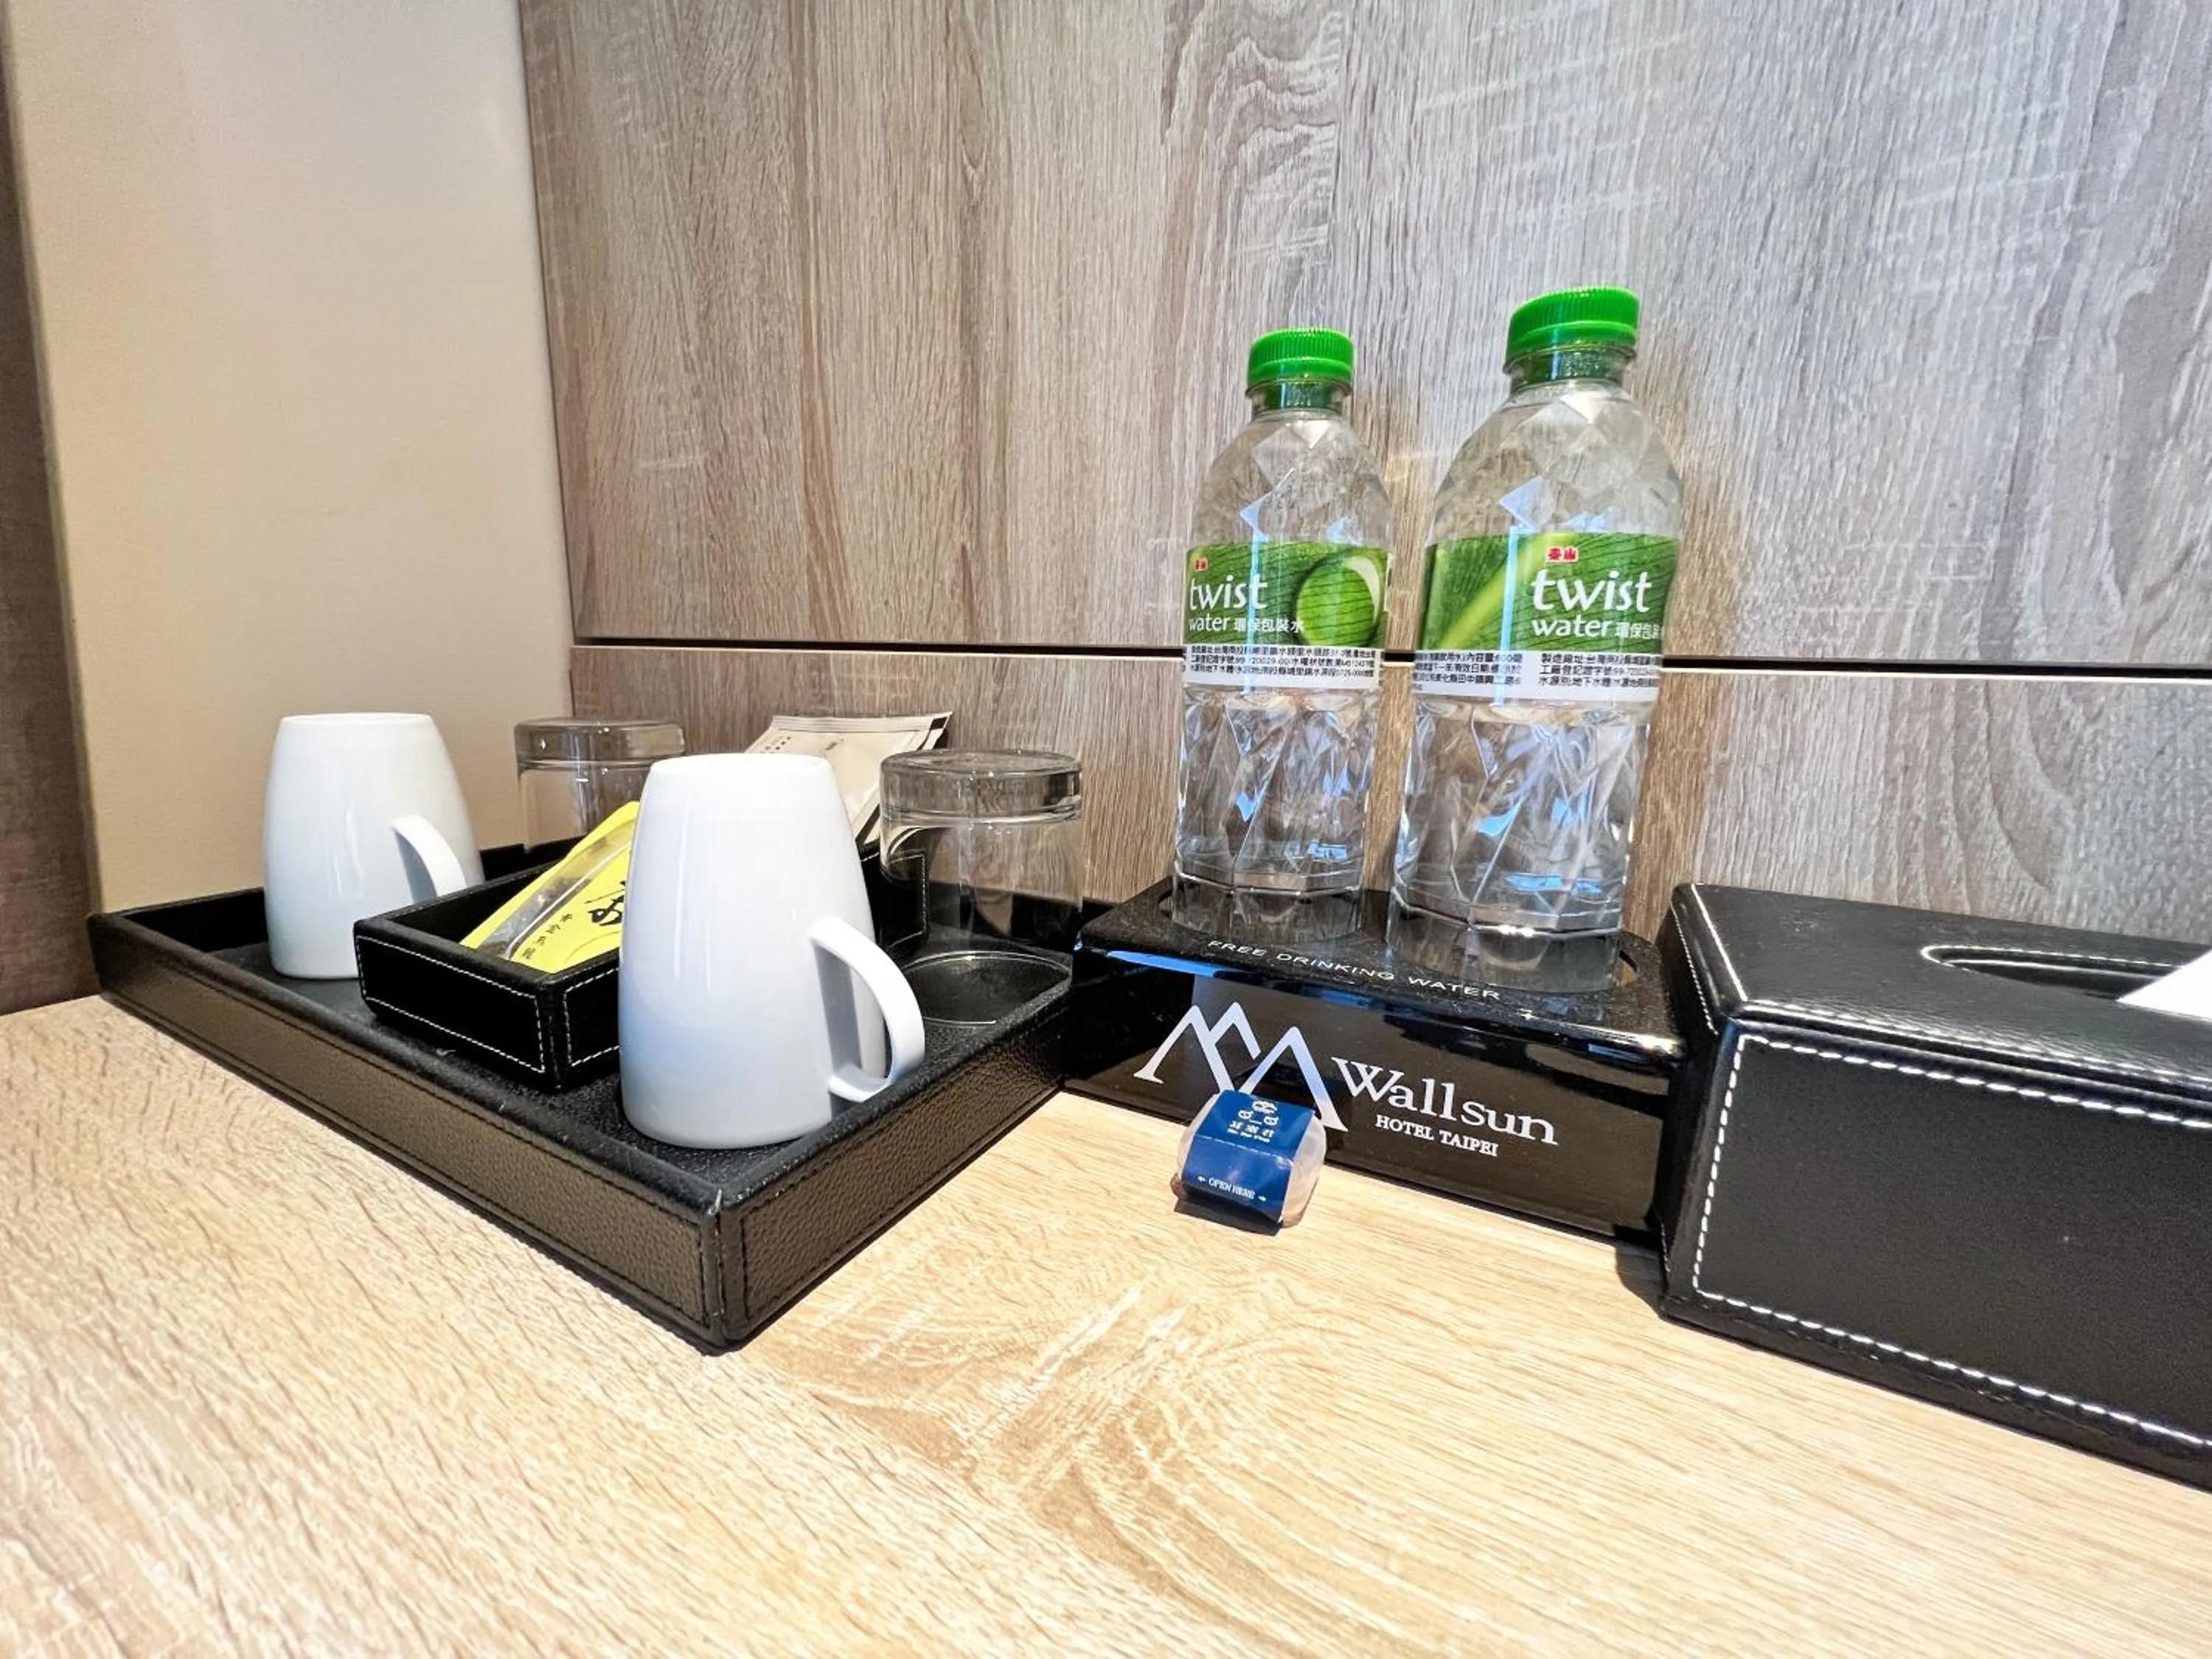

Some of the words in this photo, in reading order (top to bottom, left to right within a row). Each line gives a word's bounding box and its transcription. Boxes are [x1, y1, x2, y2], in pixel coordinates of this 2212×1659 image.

[1189, 574, 1268, 611] twist
[1531, 568, 1652, 613] twist
[1189, 613, 1230, 632] water
[1531, 615, 1613, 637] water
[1207, 939, 1267, 957] FREE
[1276, 953, 1395, 981] DRINKING
[1408, 975, 1501, 1001] WATER
[1375, 1114, 1434, 1141] HOTEL
[1439, 1130, 1498, 1157] TAIPEI
[1208, 1178, 1232, 1193] OPEN
[1232, 1184, 1256, 1200] HERE
